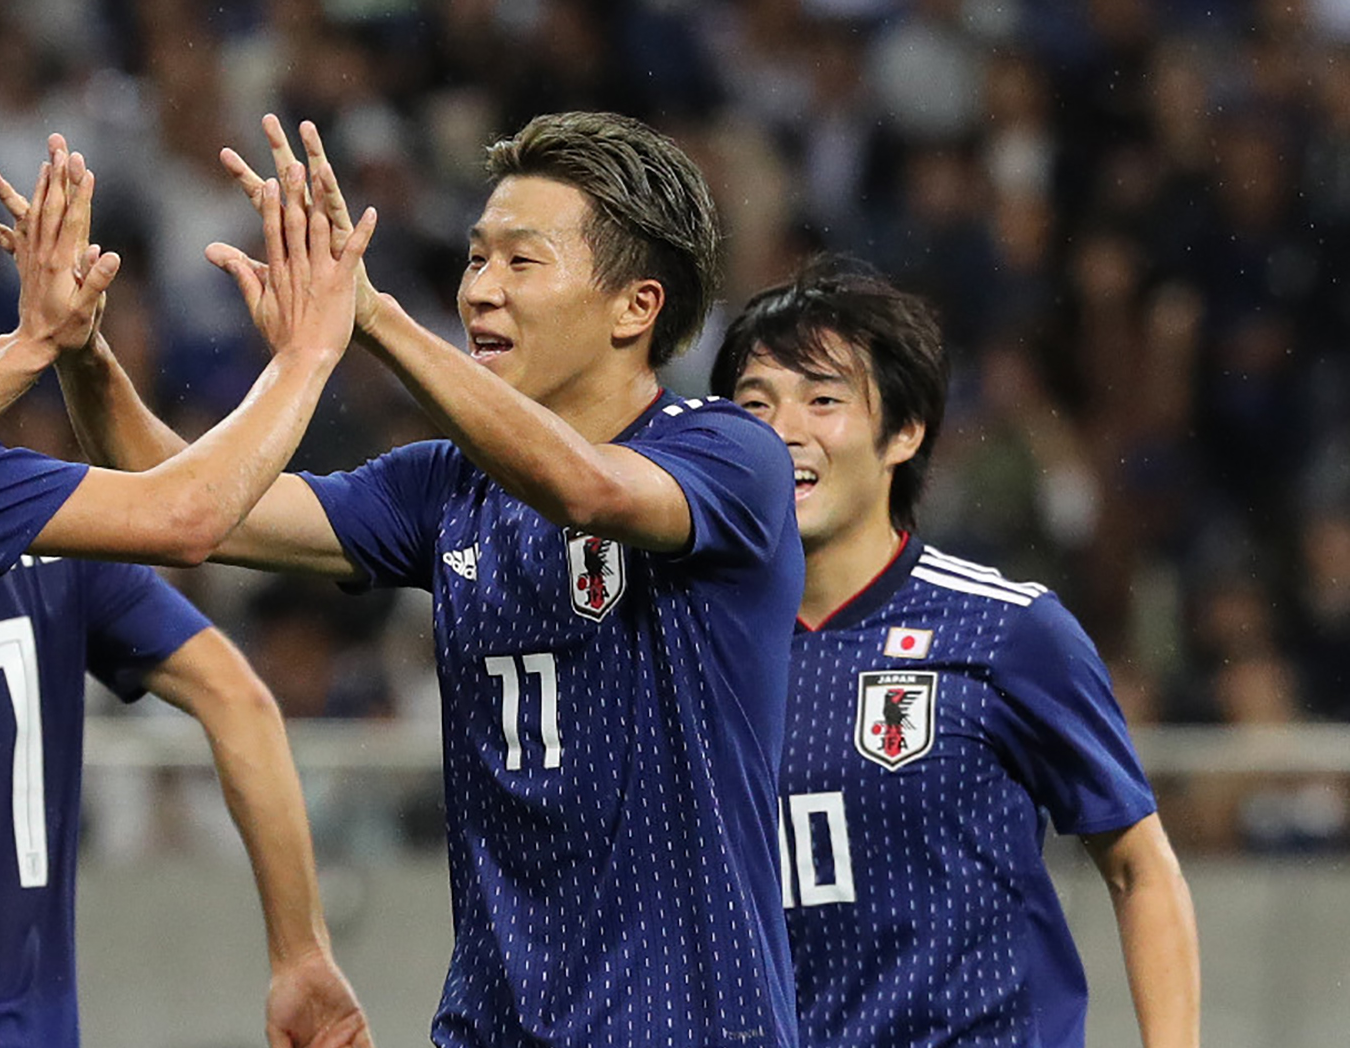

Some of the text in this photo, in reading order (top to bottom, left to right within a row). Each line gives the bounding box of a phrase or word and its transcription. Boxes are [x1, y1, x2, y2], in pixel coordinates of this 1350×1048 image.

[877, 674, 917, 685] JAPAN
[484, 652, 562, 771] 11
[876, 736, 909, 751] JFA
